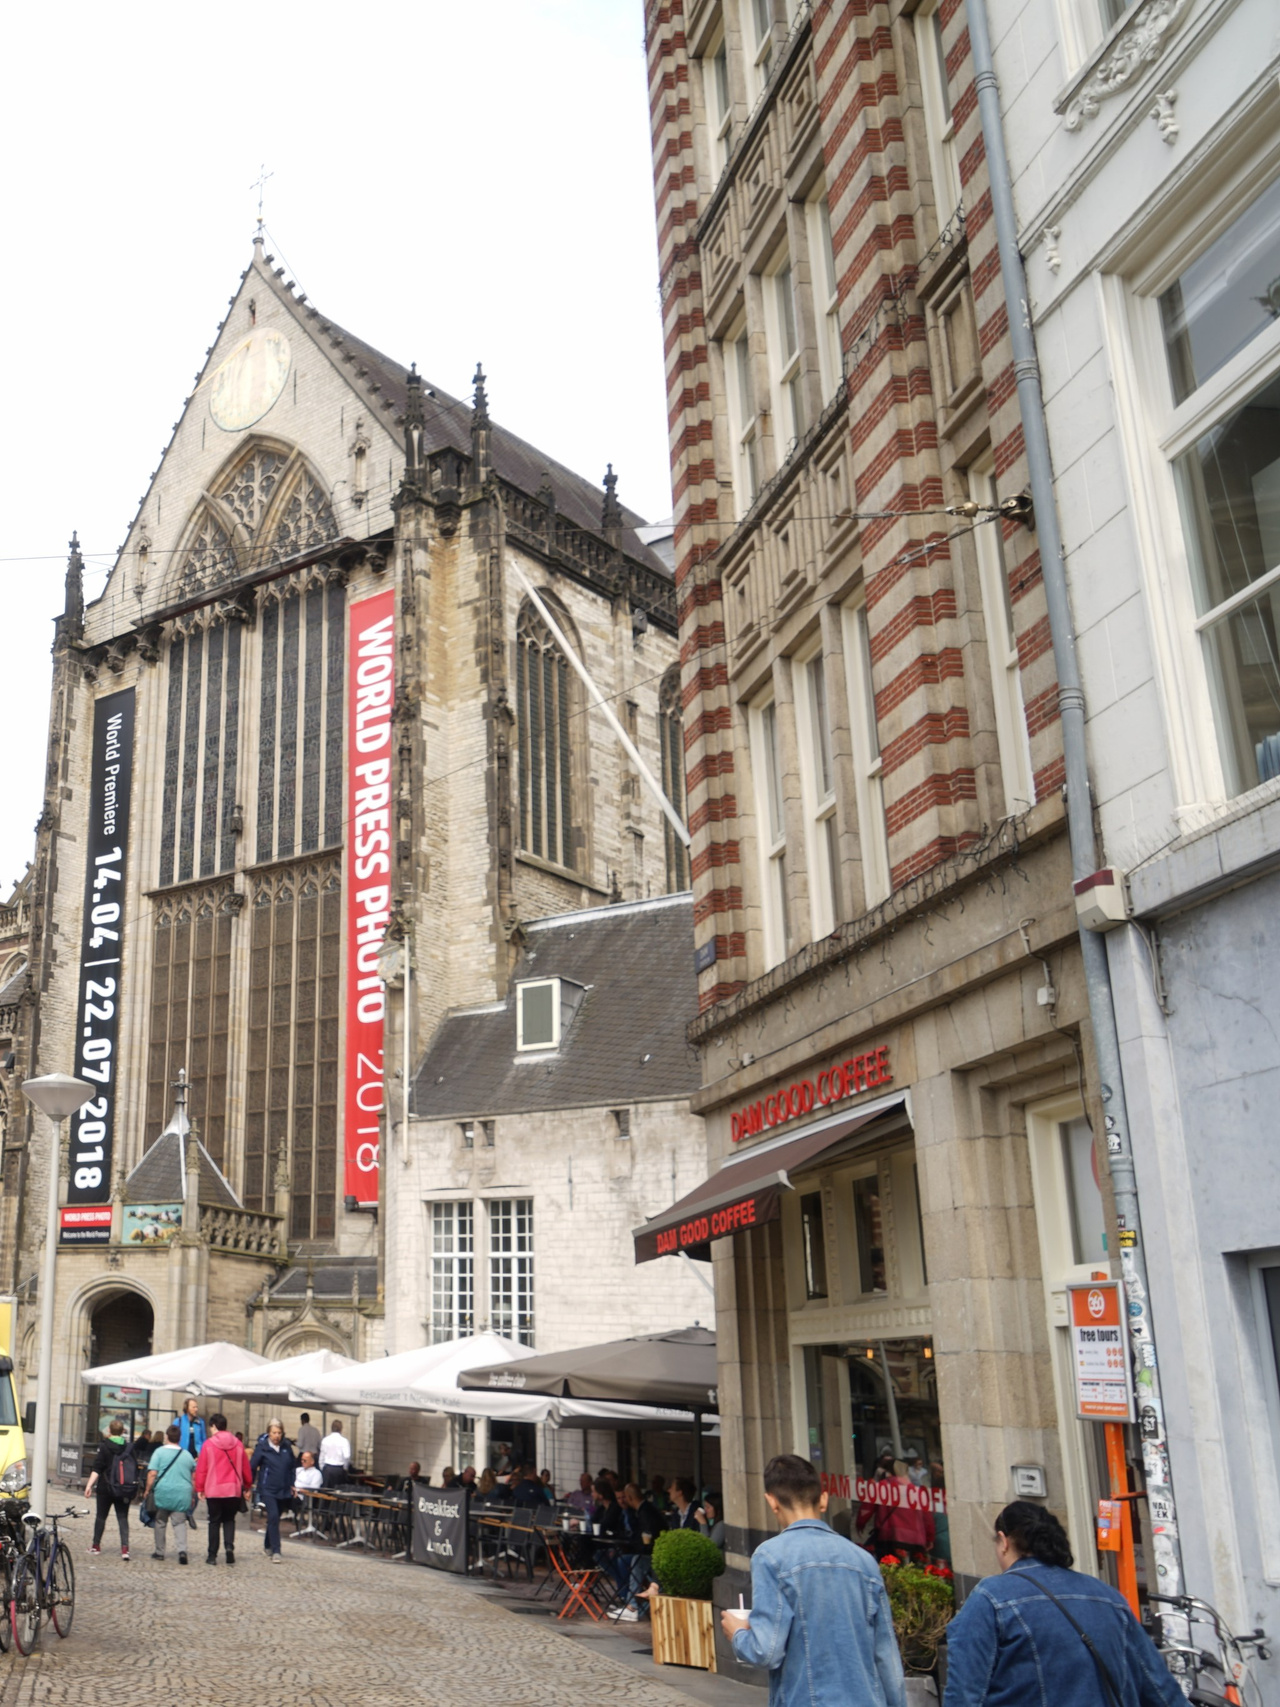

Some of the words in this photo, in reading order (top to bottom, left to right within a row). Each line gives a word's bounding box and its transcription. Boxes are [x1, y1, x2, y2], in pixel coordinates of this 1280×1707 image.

[356, 614, 393, 753] WORLD
[105, 712, 123, 761] World
[103, 764, 120, 836] Premiere
[355, 757, 390, 880] PRESS
[89, 846, 122, 949] 14.04
[355, 884, 389, 1024] PHOTO
[356, 1049, 384, 1172] 2018
[730, 1101, 764, 1142] DAM
[764, 1080, 814, 1127] GOOD
[817, 1045, 892, 1105] COFFEE
[64, 1213, 80, 1222] WORLD
[95, 1211, 111, 1221] PHOTO
[656, 1227, 678, 1254] DAM
[679, 1218, 709, 1246] GOOD
[711, 1199, 756, 1235] COFFEE
[1080, 1328, 1096, 1342] free
[1097, 1329, 1119, 1342] tours
[359, 1390, 400, 1400] Restaurant
[418, 1496, 460, 1518] Breakfast
[820, 1472, 851, 1499] DAM
[855, 1477, 901, 1507] GOOD
